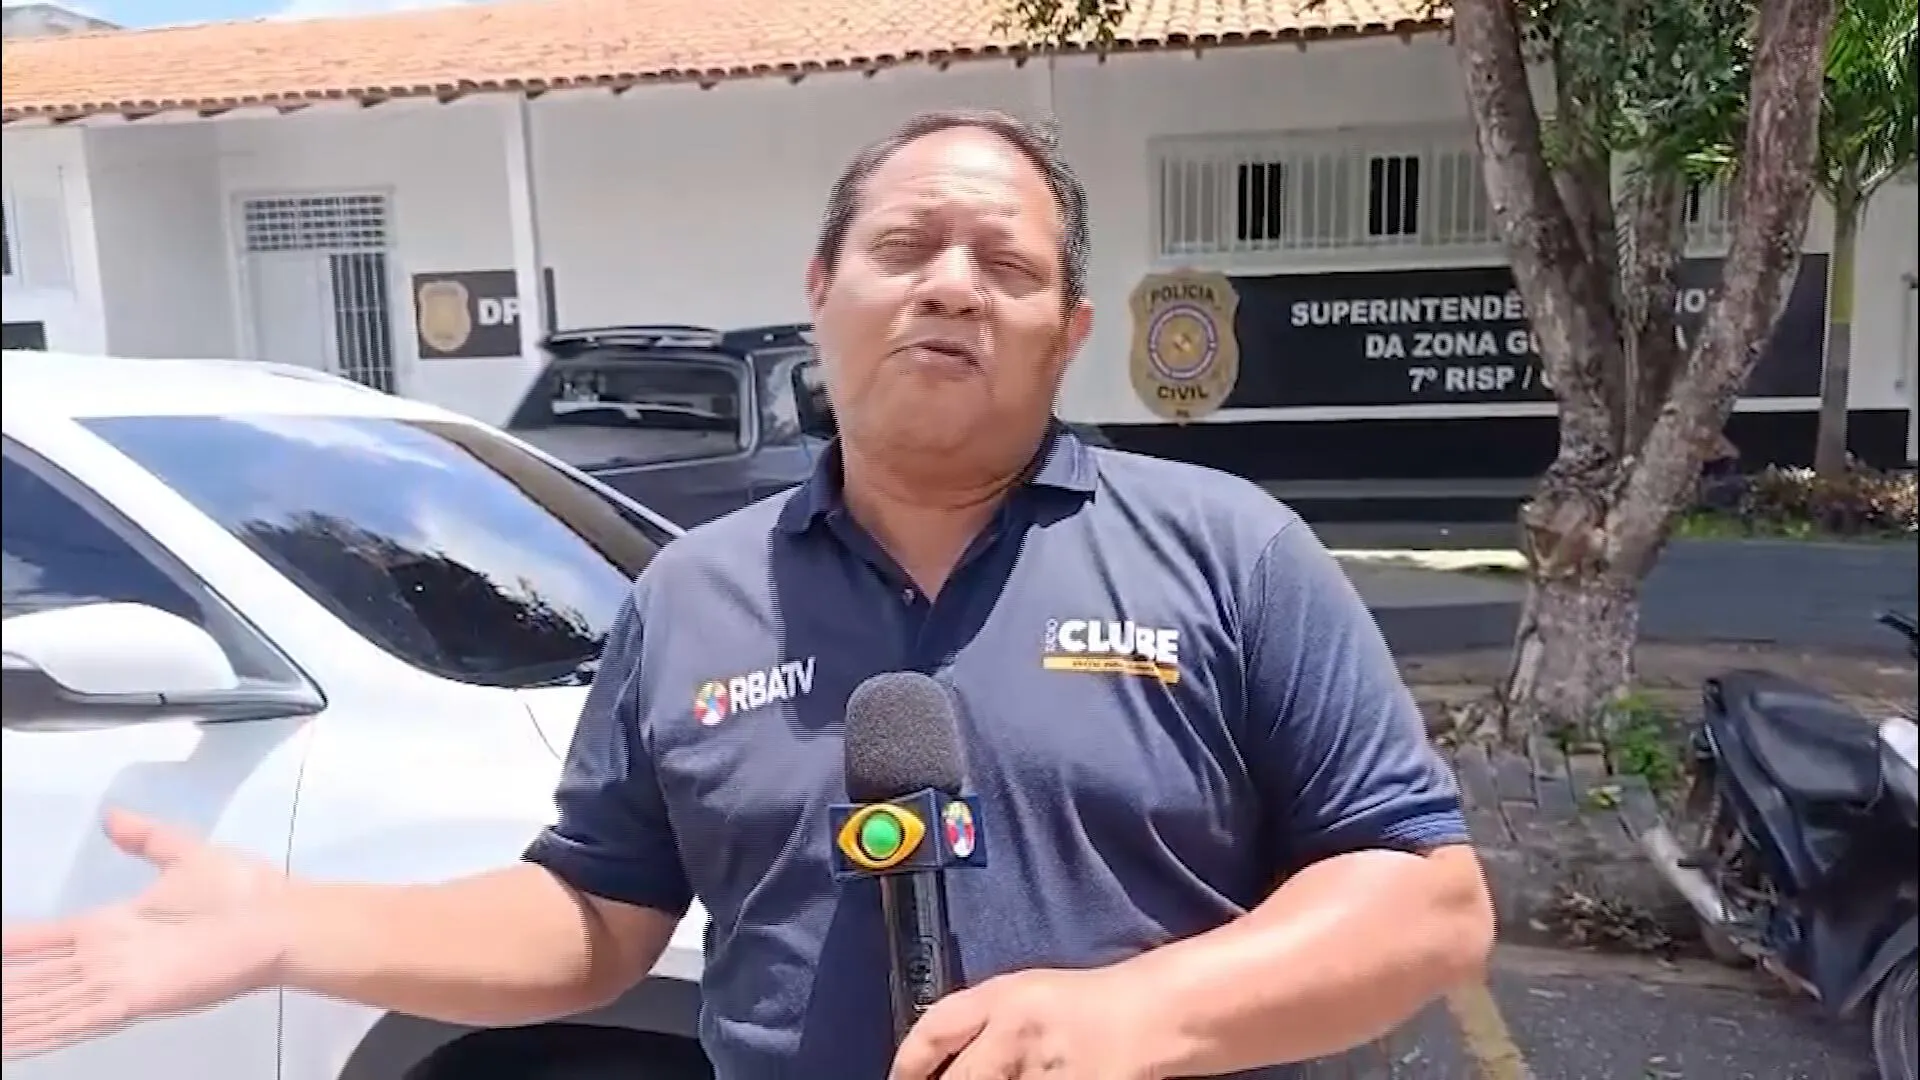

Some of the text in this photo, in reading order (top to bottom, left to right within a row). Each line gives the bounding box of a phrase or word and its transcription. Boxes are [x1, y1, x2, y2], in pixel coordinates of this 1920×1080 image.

[1290, 288, 1534, 327] SUPERINTENDÊ
[1364, 333, 1406, 359] DA
[1412, 331, 1499, 358] ZONA
[1157, 384, 1210, 401] CIVIL
[1444, 366, 1516, 392] RISP
[1058, 619, 1180, 665] CLUBE
[729, 655, 817, 714] RBATV
